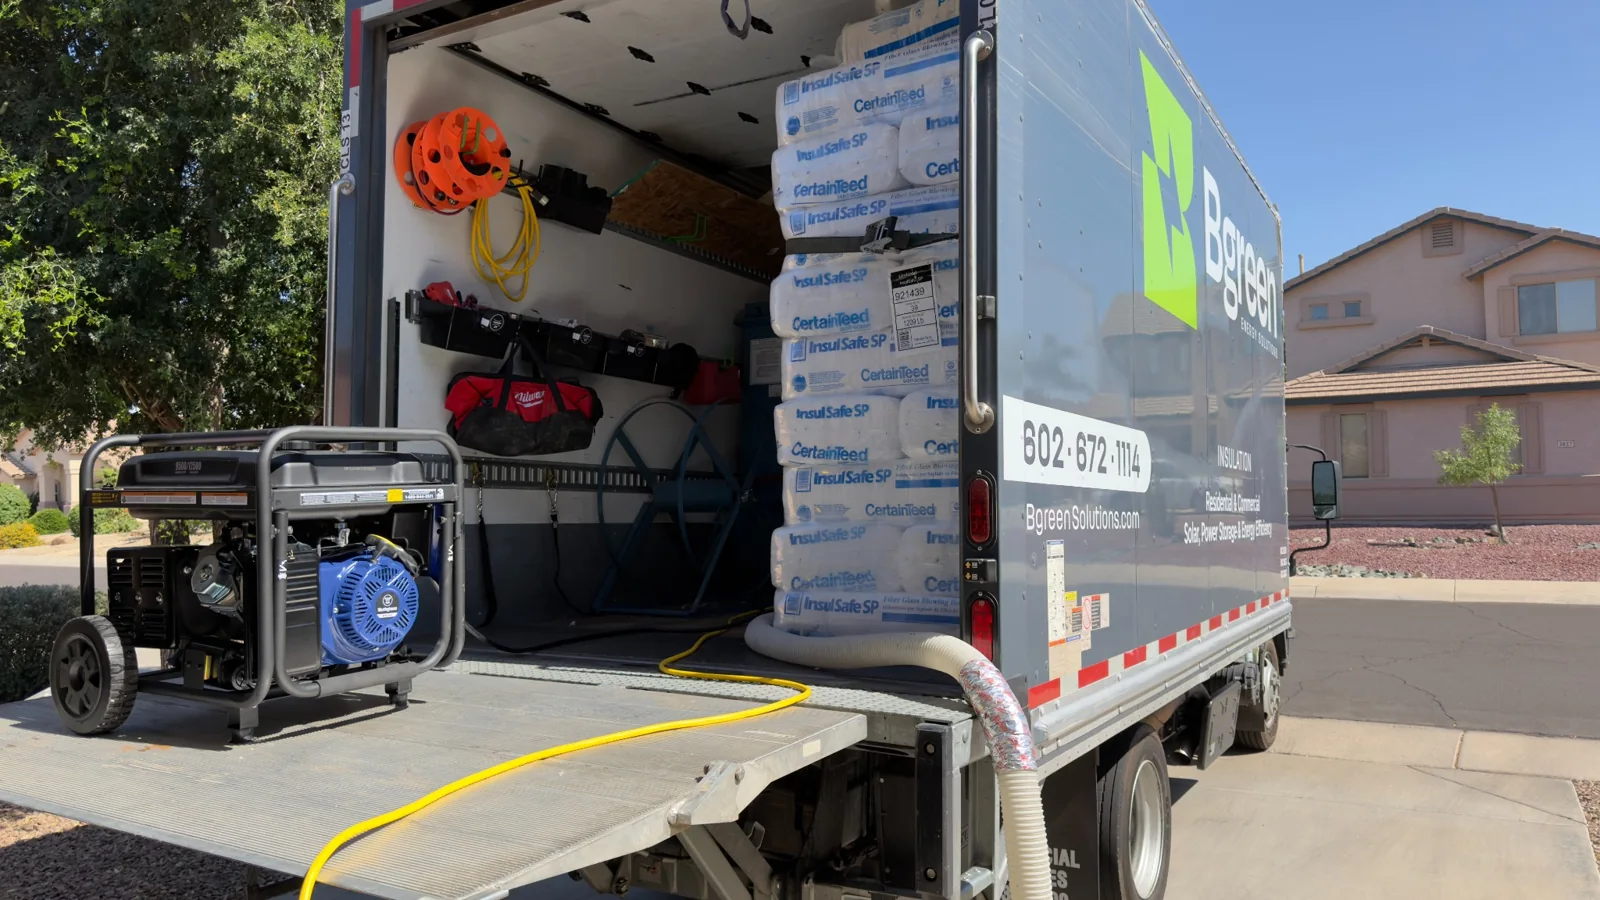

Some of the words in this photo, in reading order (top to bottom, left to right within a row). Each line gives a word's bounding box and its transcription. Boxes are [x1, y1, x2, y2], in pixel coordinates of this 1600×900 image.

[801, 67, 863, 93] InsulSafe
[864, 61, 880, 77] SP
[853, 84, 925, 113] CertainTeed
[796, 138, 851, 162] InsulSafe
[852, 132, 868, 148] SP
[794, 174, 868, 198] CertainTeed
[807, 203, 868, 226] InsulSafe
[869, 200, 887, 215] SP
[1203, 165, 1277, 338] Bgreen
[852, 268, 868, 281] SP
[894, 286, 925, 301] 921439
[792, 308, 870, 331] CertainTeed
[1240, 316, 1257, 341] ENERGY
[808, 336, 869, 354] InsulSafe
[870, 333, 887, 348] SP
[861, 364, 929, 381] CertainTeed
[796, 404, 853, 420] InsulSafe
[854, 403, 870, 417] SP
[791, 441, 869, 462] CertainTeed
[1217, 445, 1252, 472] INSULATION
[813, 469, 874, 486] InsulSafe
[875, 468, 892, 483] SP
[865, 503, 936, 517] CertainTeed
[1205, 491, 1233, 512] Residential
[1238, 494, 1260, 512] Commercial
[1026, 503, 1140, 535] BgreenSolutions.com
[789, 528, 849, 545] InsulSafe
[850, 526, 866, 539] SP
[1201, 522, 1218, 542] Power
[1219, 522, 1237, 543] Storage
[1242, 521, 1255, 541] Energy
[791, 570, 876, 591] CertainTeed
[804, 597, 861, 613] InsulSafe
[863, 600, 879, 614] SP
